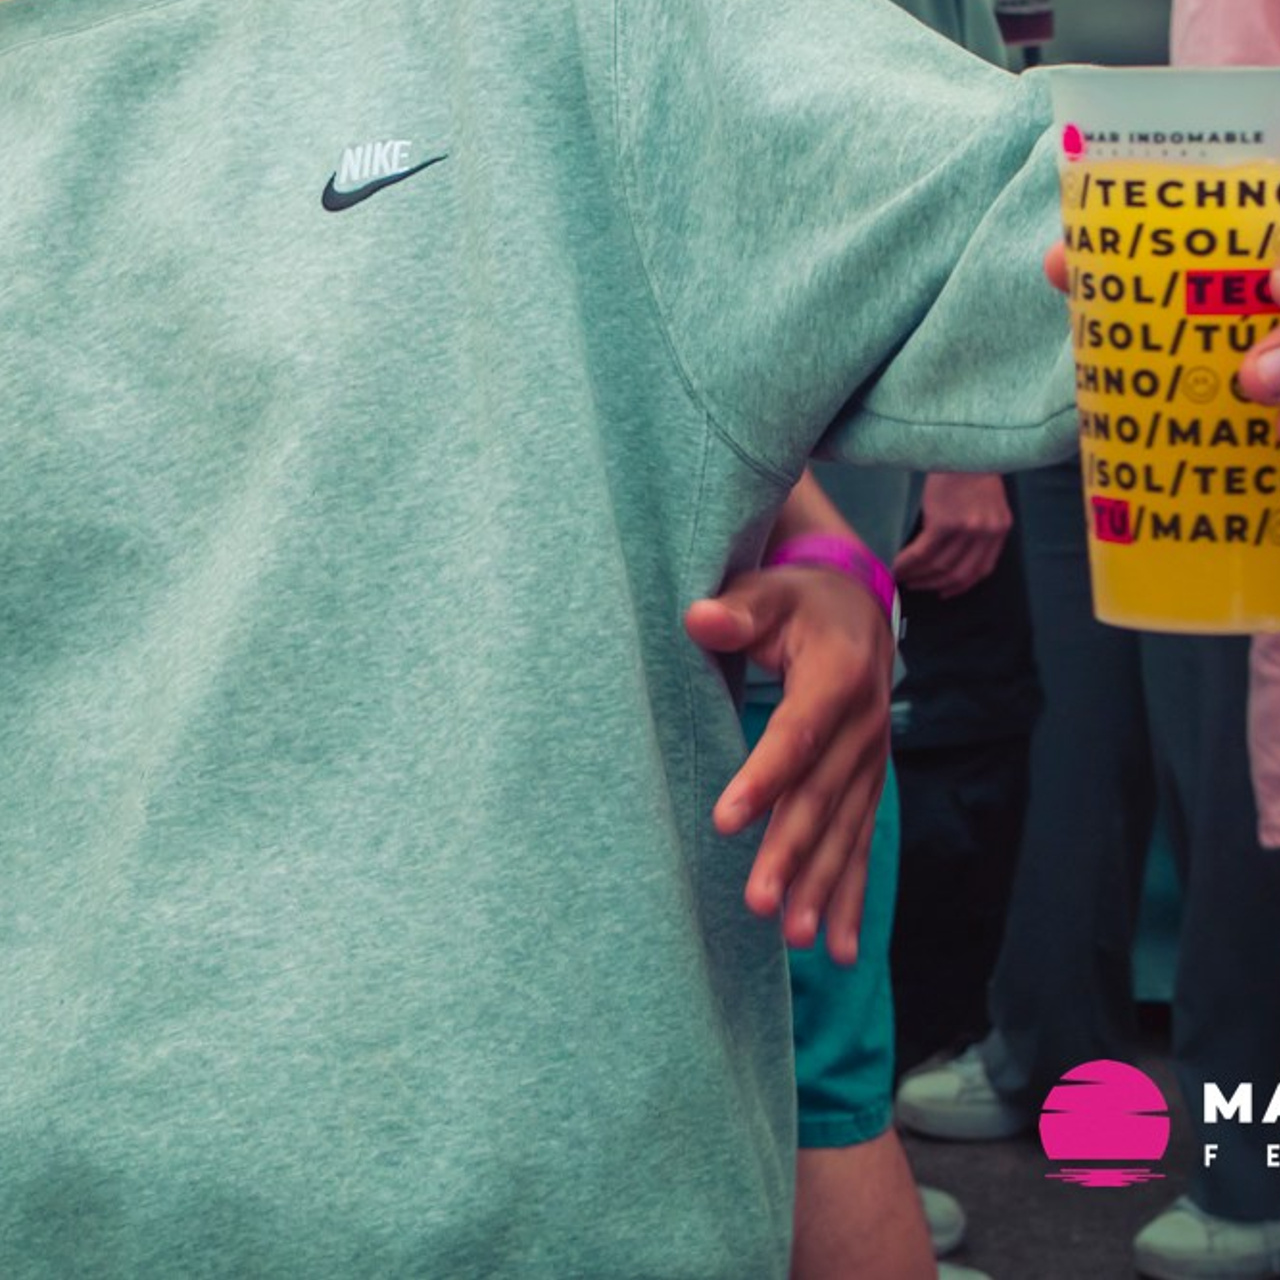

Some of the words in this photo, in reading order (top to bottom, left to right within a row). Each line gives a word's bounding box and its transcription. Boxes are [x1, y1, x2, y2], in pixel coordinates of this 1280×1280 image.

[1129, 131, 1264, 145] INDOMABLE
[339, 140, 412, 184] NIKE
[1080, 173, 1280, 209] /TECHN
